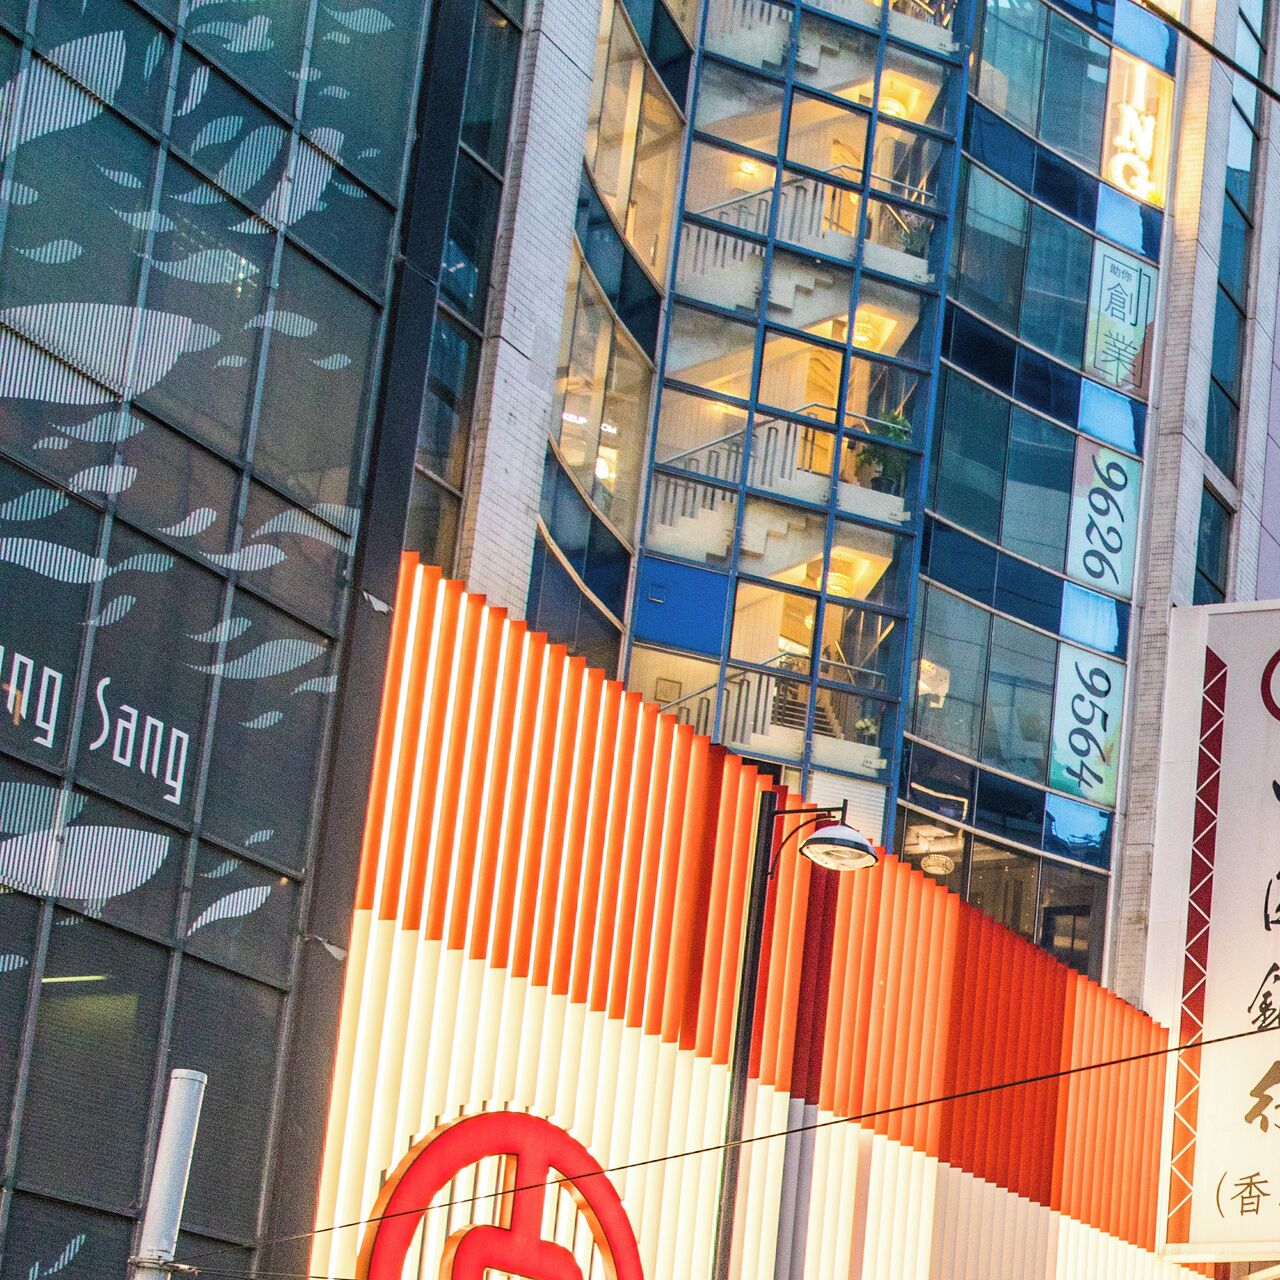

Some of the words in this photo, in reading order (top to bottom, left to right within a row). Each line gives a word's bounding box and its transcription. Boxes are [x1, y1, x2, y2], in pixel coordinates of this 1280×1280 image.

[1103, 282, 1139, 385] 創業
[1083, 454, 1129, 585] 9626
[0, 645, 62, 750] ng
[89, 676, 190, 806] Sang
[1065, 661, 1112, 789] 9564
